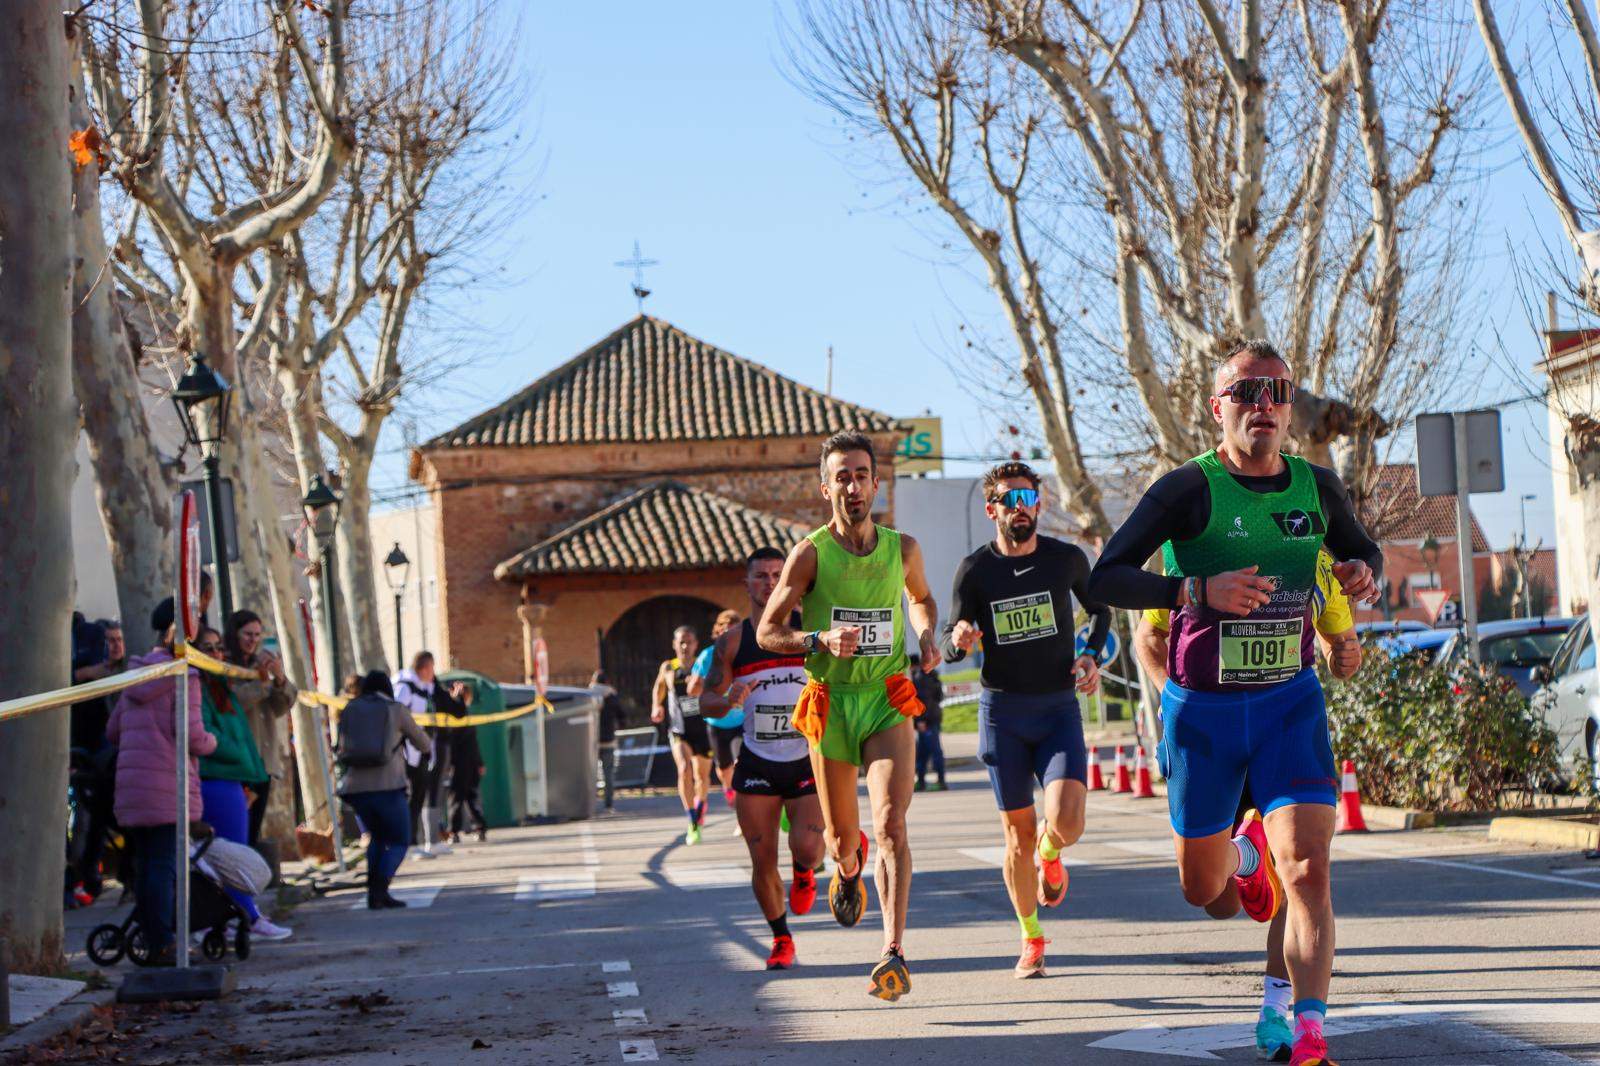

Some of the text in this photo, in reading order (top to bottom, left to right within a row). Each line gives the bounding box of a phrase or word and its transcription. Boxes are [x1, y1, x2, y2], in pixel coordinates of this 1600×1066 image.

[1006, 608, 1042, 630] 1074
[852, 624, 877, 644] 15
[1231, 624, 1257, 636] ALOVERA
[1240, 639, 1286, 666] 1091
